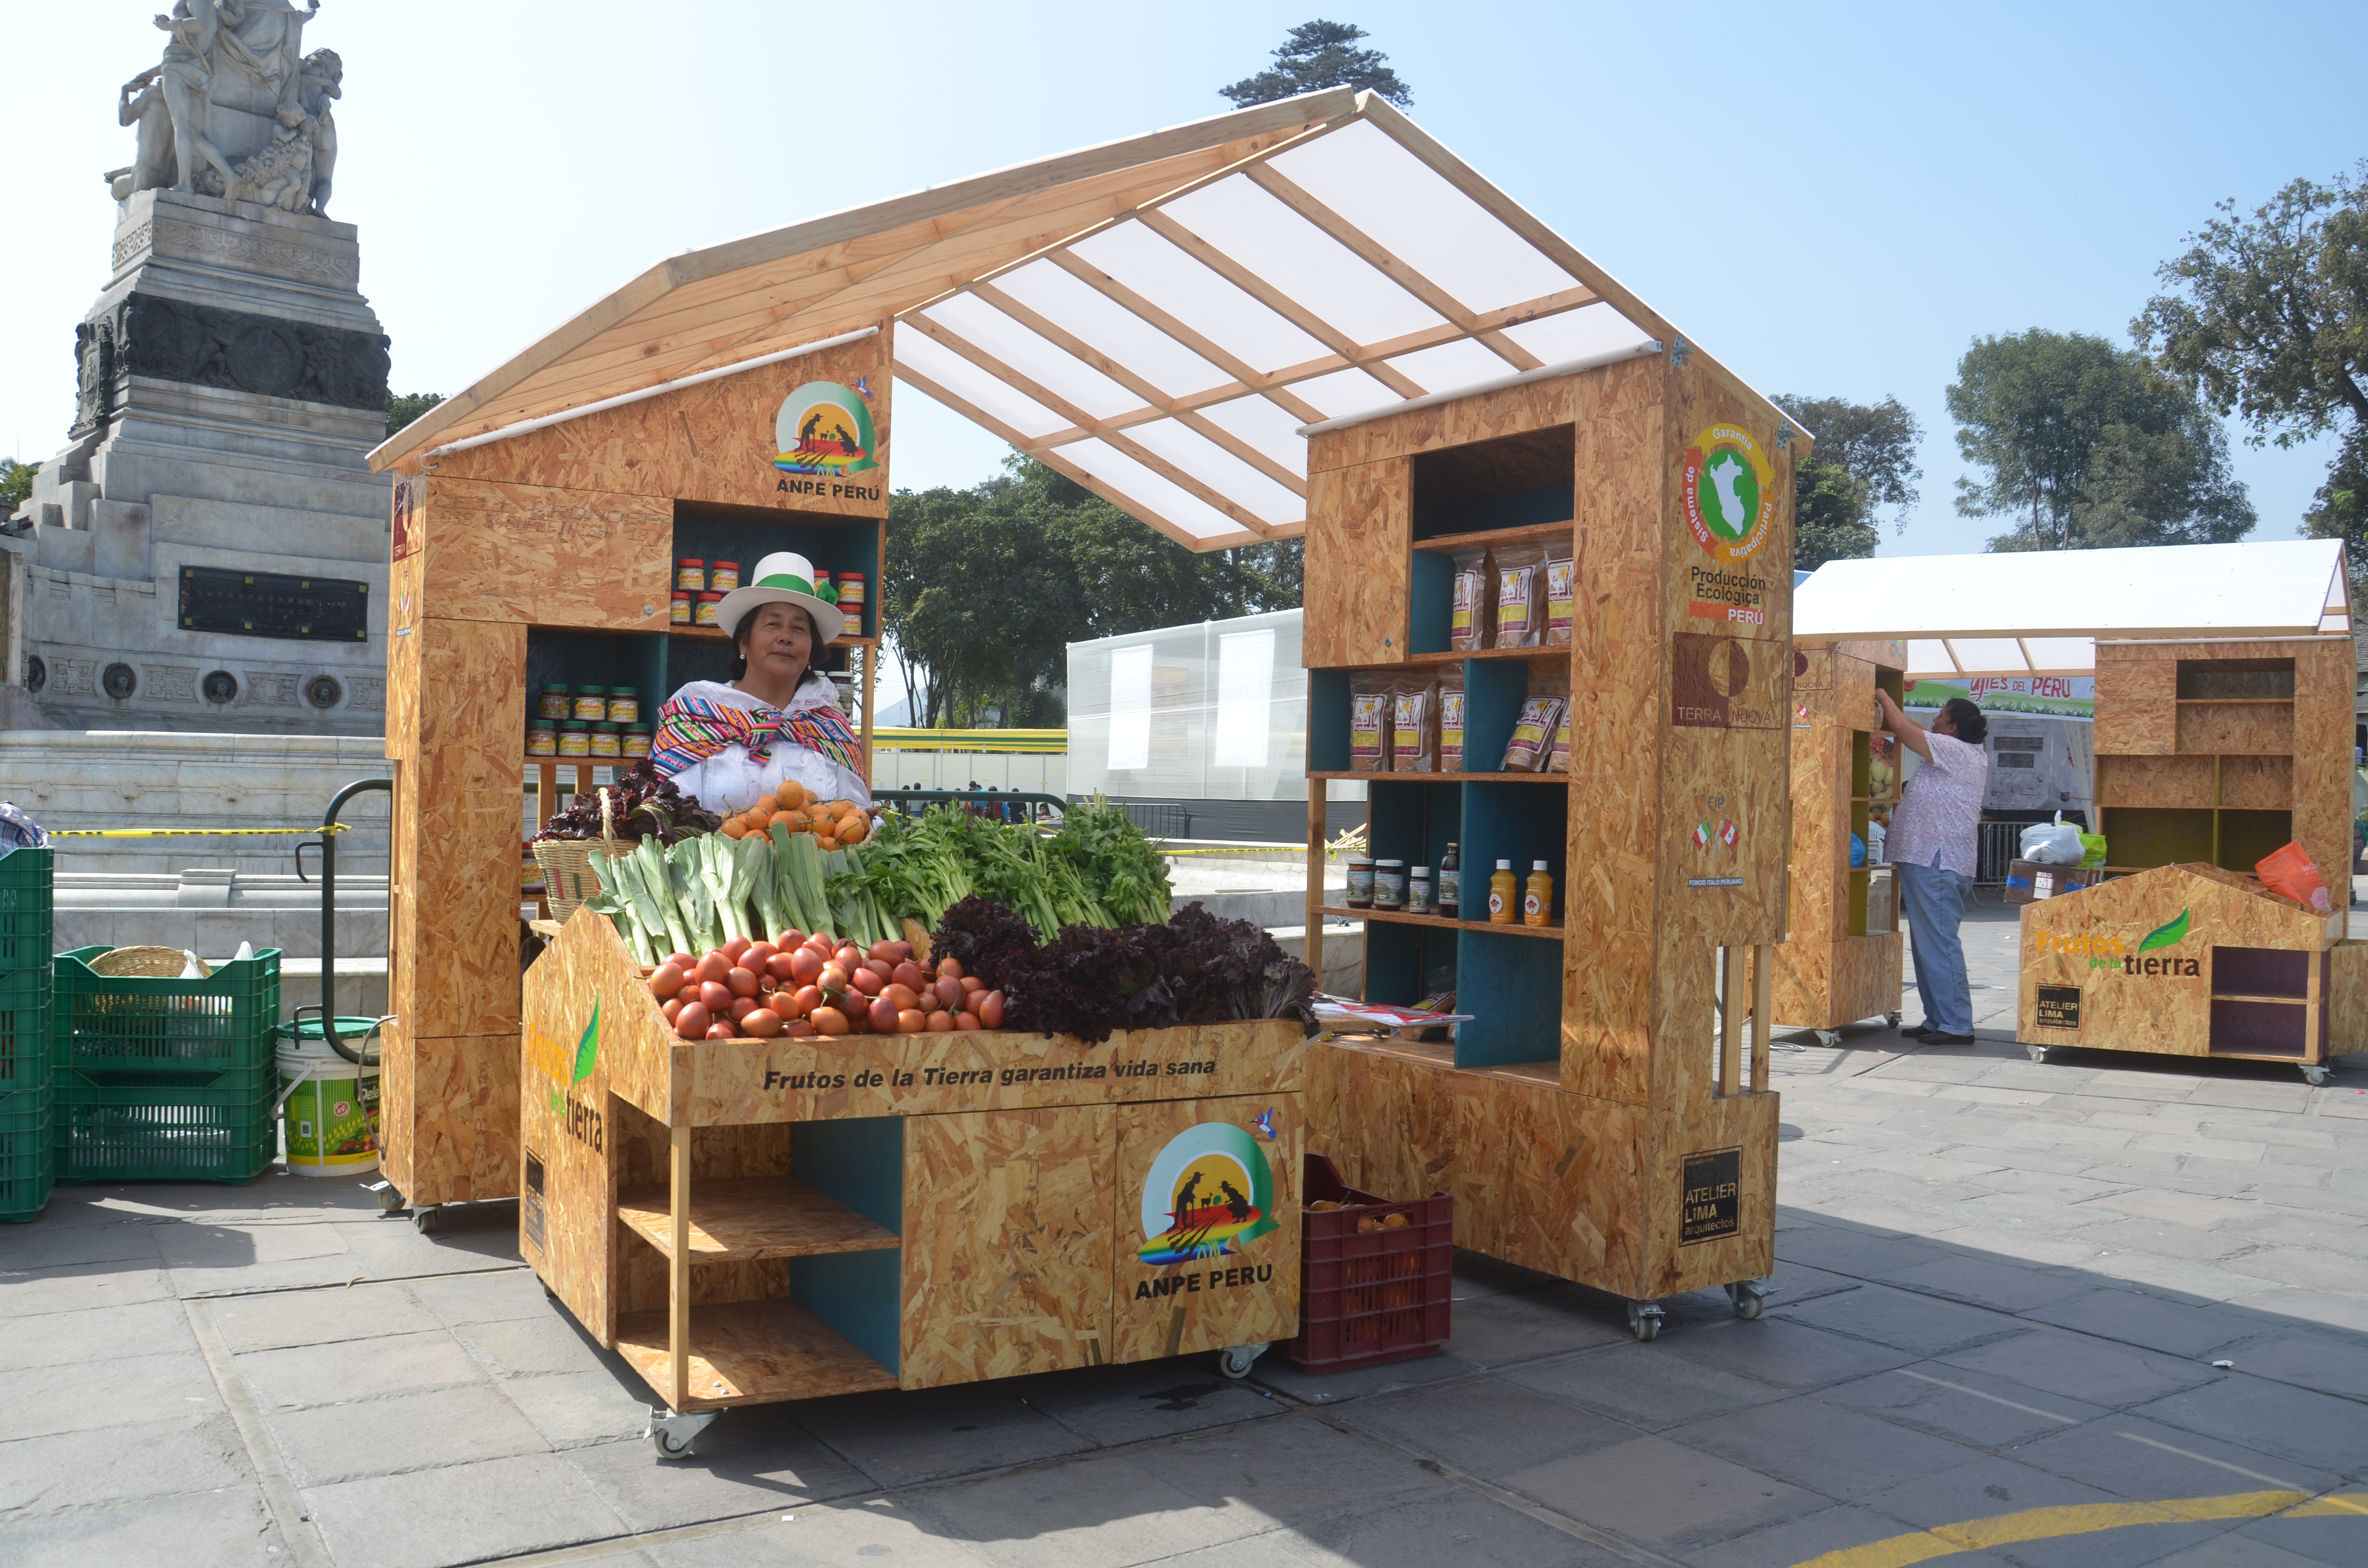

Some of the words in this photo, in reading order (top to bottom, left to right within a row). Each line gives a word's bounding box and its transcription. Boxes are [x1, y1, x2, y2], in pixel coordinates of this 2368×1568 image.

[1713, 428, 1752, 451] Garantía
[1686, 466, 1695, 482] de
[777, 479, 826, 496] ANPE
[833, 484, 880, 501] PERÚ
[1687, 487, 1708, 542] Sistema
[1730, 502, 1772, 558] Participativa
[1691, 566, 1765, 590] Producción
[1697, 582, 1759, 605] Ecológica
[1728, 609, 1764, 625] PERÚ
[2013, 681, 2025, 691] DEL
[1677, 707, 1721, 721] TERRA
[1732, 710, 1771, 723] NUOVA
[1708, 796, 1725, 809] FIP
[2037, 931, 2124, 955] Frutos
[2089, 956, 2106, 968] de
[2109, 956, 2121, 968] la
[2124, 955, 2200, 977] tierra
[2039, 1001, 2078, 1010] ATELIER
[2039, 1009, 2063, 1018] LIMA
[530, 1021, 567, 1087] Frutos
[764, 1070, 845, 1090] Frutos
[853, 1070, 882, 1088] de
[892, 1069, 913, 1087] la
[924, 1066, 993, 1085] Tierra
[1000, 1063, 1107, 1086] garantiza
[1114, 1059, 1159, 1078] vida
[1165, 1060, 1216, 1076] sana
[567, 1089, 603, 1155] tierra
[1685, 1182, 1736, 1205] ATELIER
[1685, 1204, 1717, 1223] LIMA
[1685, 1218, 1735, 1236] arquitectos
[1135, 1273, 1201, 1300] ANPE
[1209, 1263, 1272, 1289] PERU
